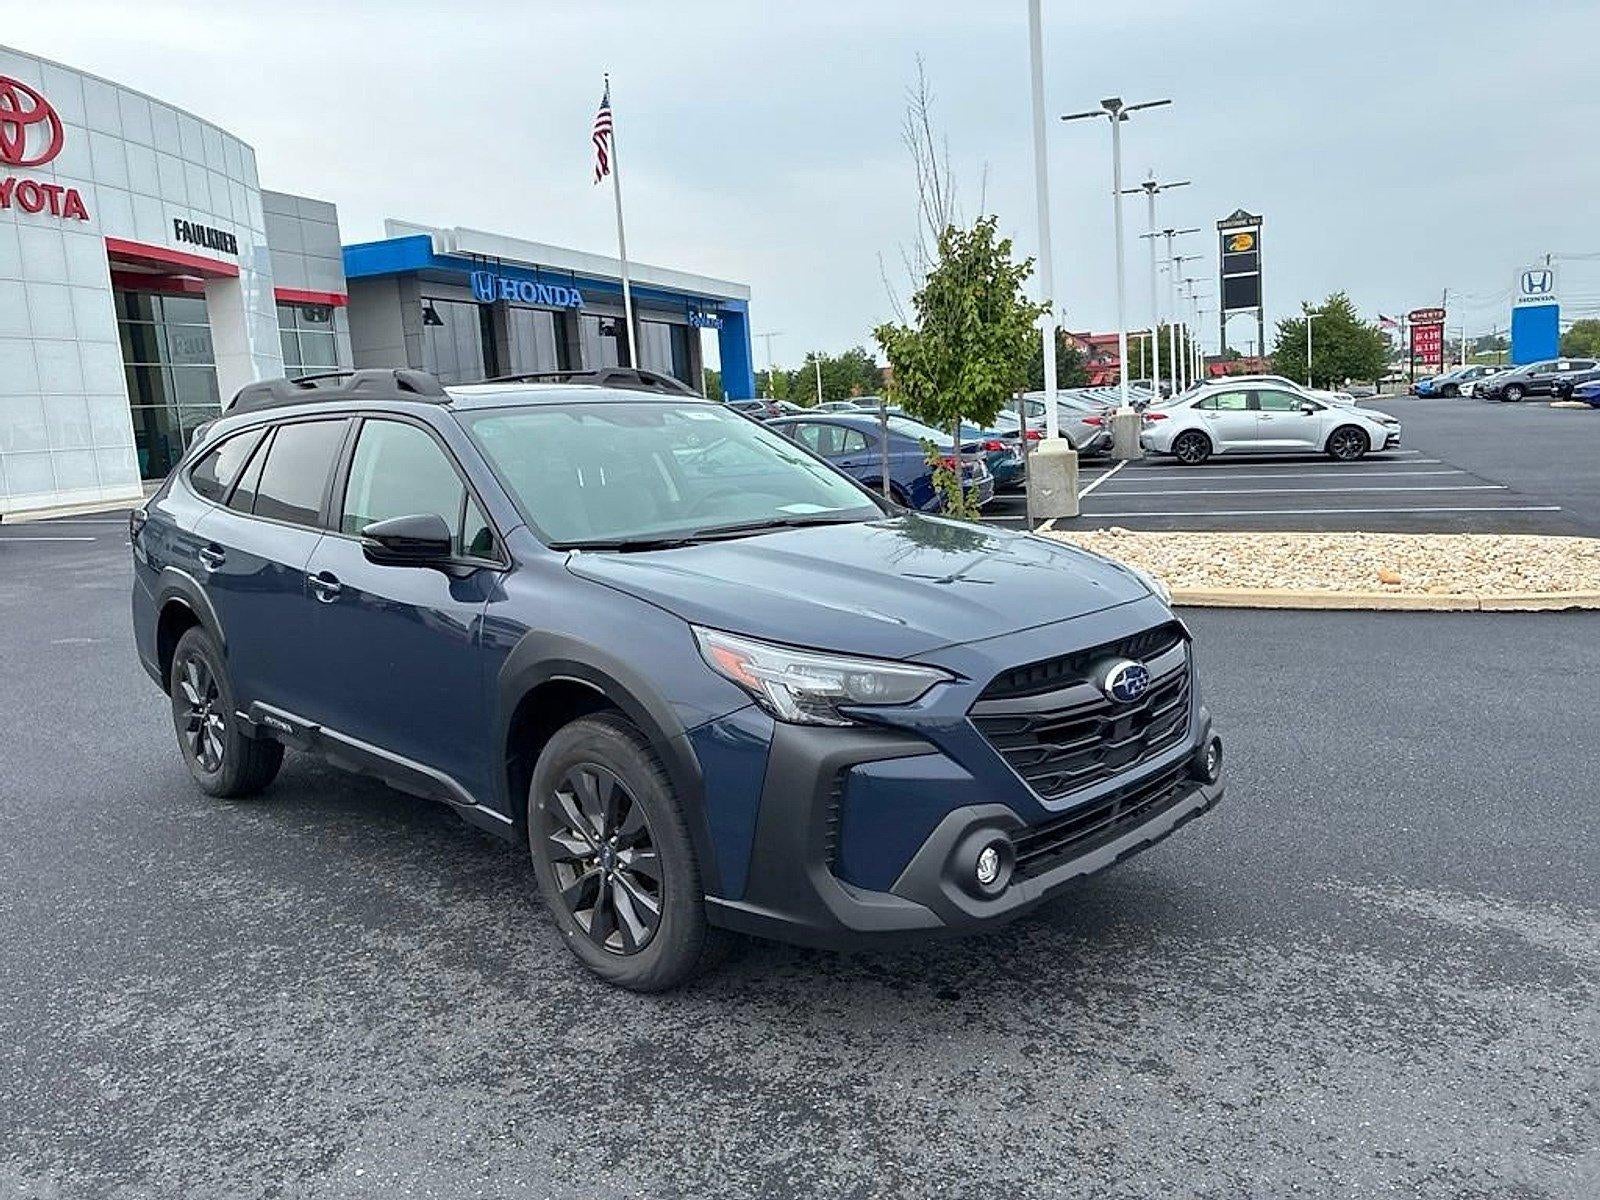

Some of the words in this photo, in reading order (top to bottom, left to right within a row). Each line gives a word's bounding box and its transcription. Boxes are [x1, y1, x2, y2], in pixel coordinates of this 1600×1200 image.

[173, 218, 238, 255] FAULKNER
[499, 277, 584, 308] HONDA
[1518, 295, 1556, 303] HONDA
